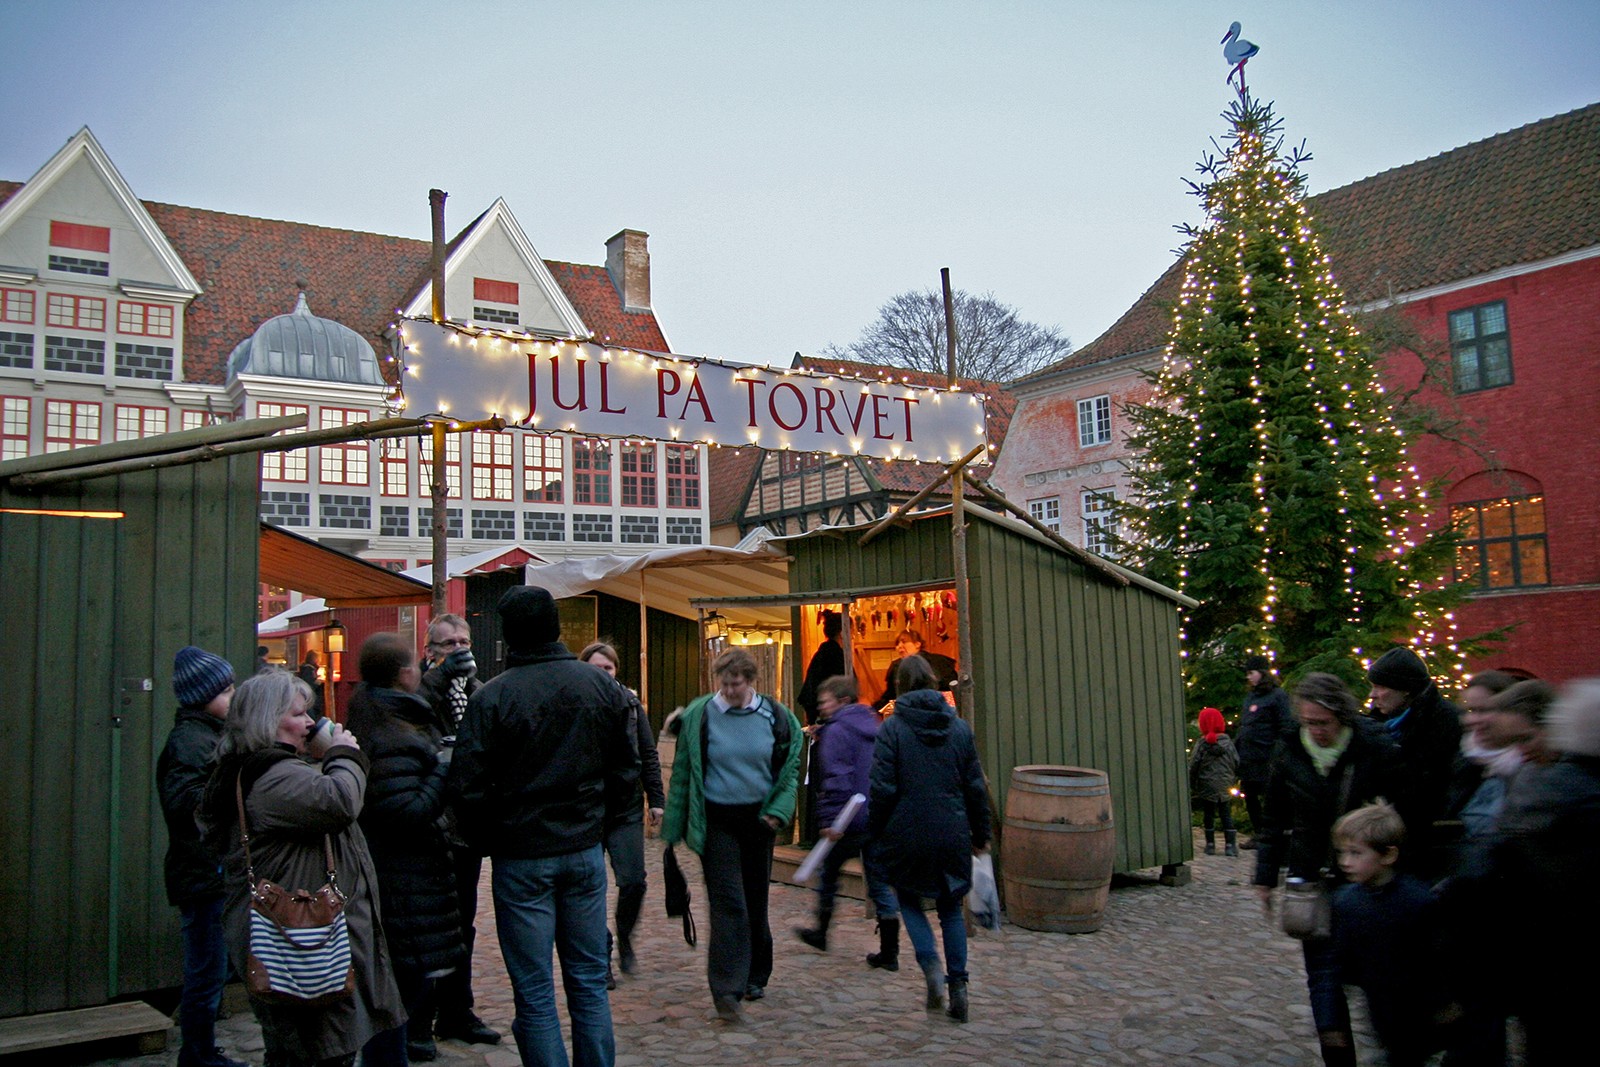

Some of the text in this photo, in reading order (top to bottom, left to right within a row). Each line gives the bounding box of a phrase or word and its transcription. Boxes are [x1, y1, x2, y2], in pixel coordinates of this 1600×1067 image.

[522, 353, 921, 442] JUL PÅ TORVET
